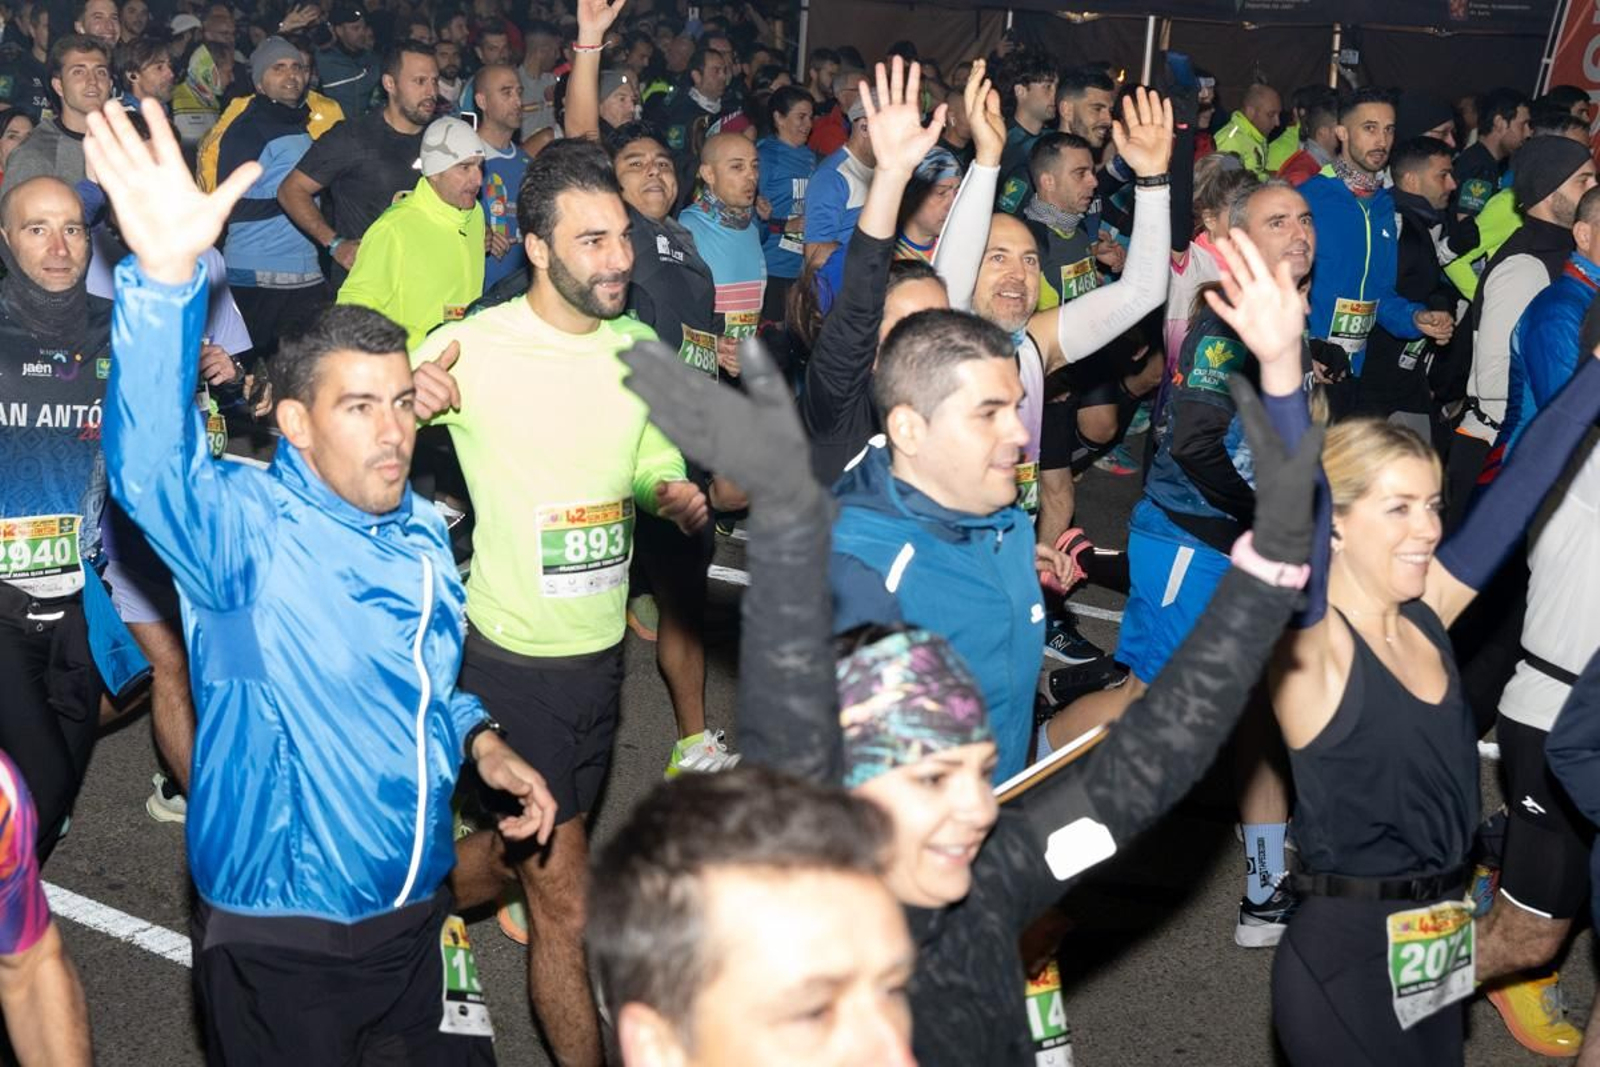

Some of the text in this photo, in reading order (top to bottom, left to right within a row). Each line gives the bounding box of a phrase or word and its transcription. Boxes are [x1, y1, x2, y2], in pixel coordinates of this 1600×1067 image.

[1068, 271, 1097, 297] 1468
[566, 508, 587, 523] 42
[564, 523, 625, 562] 893
